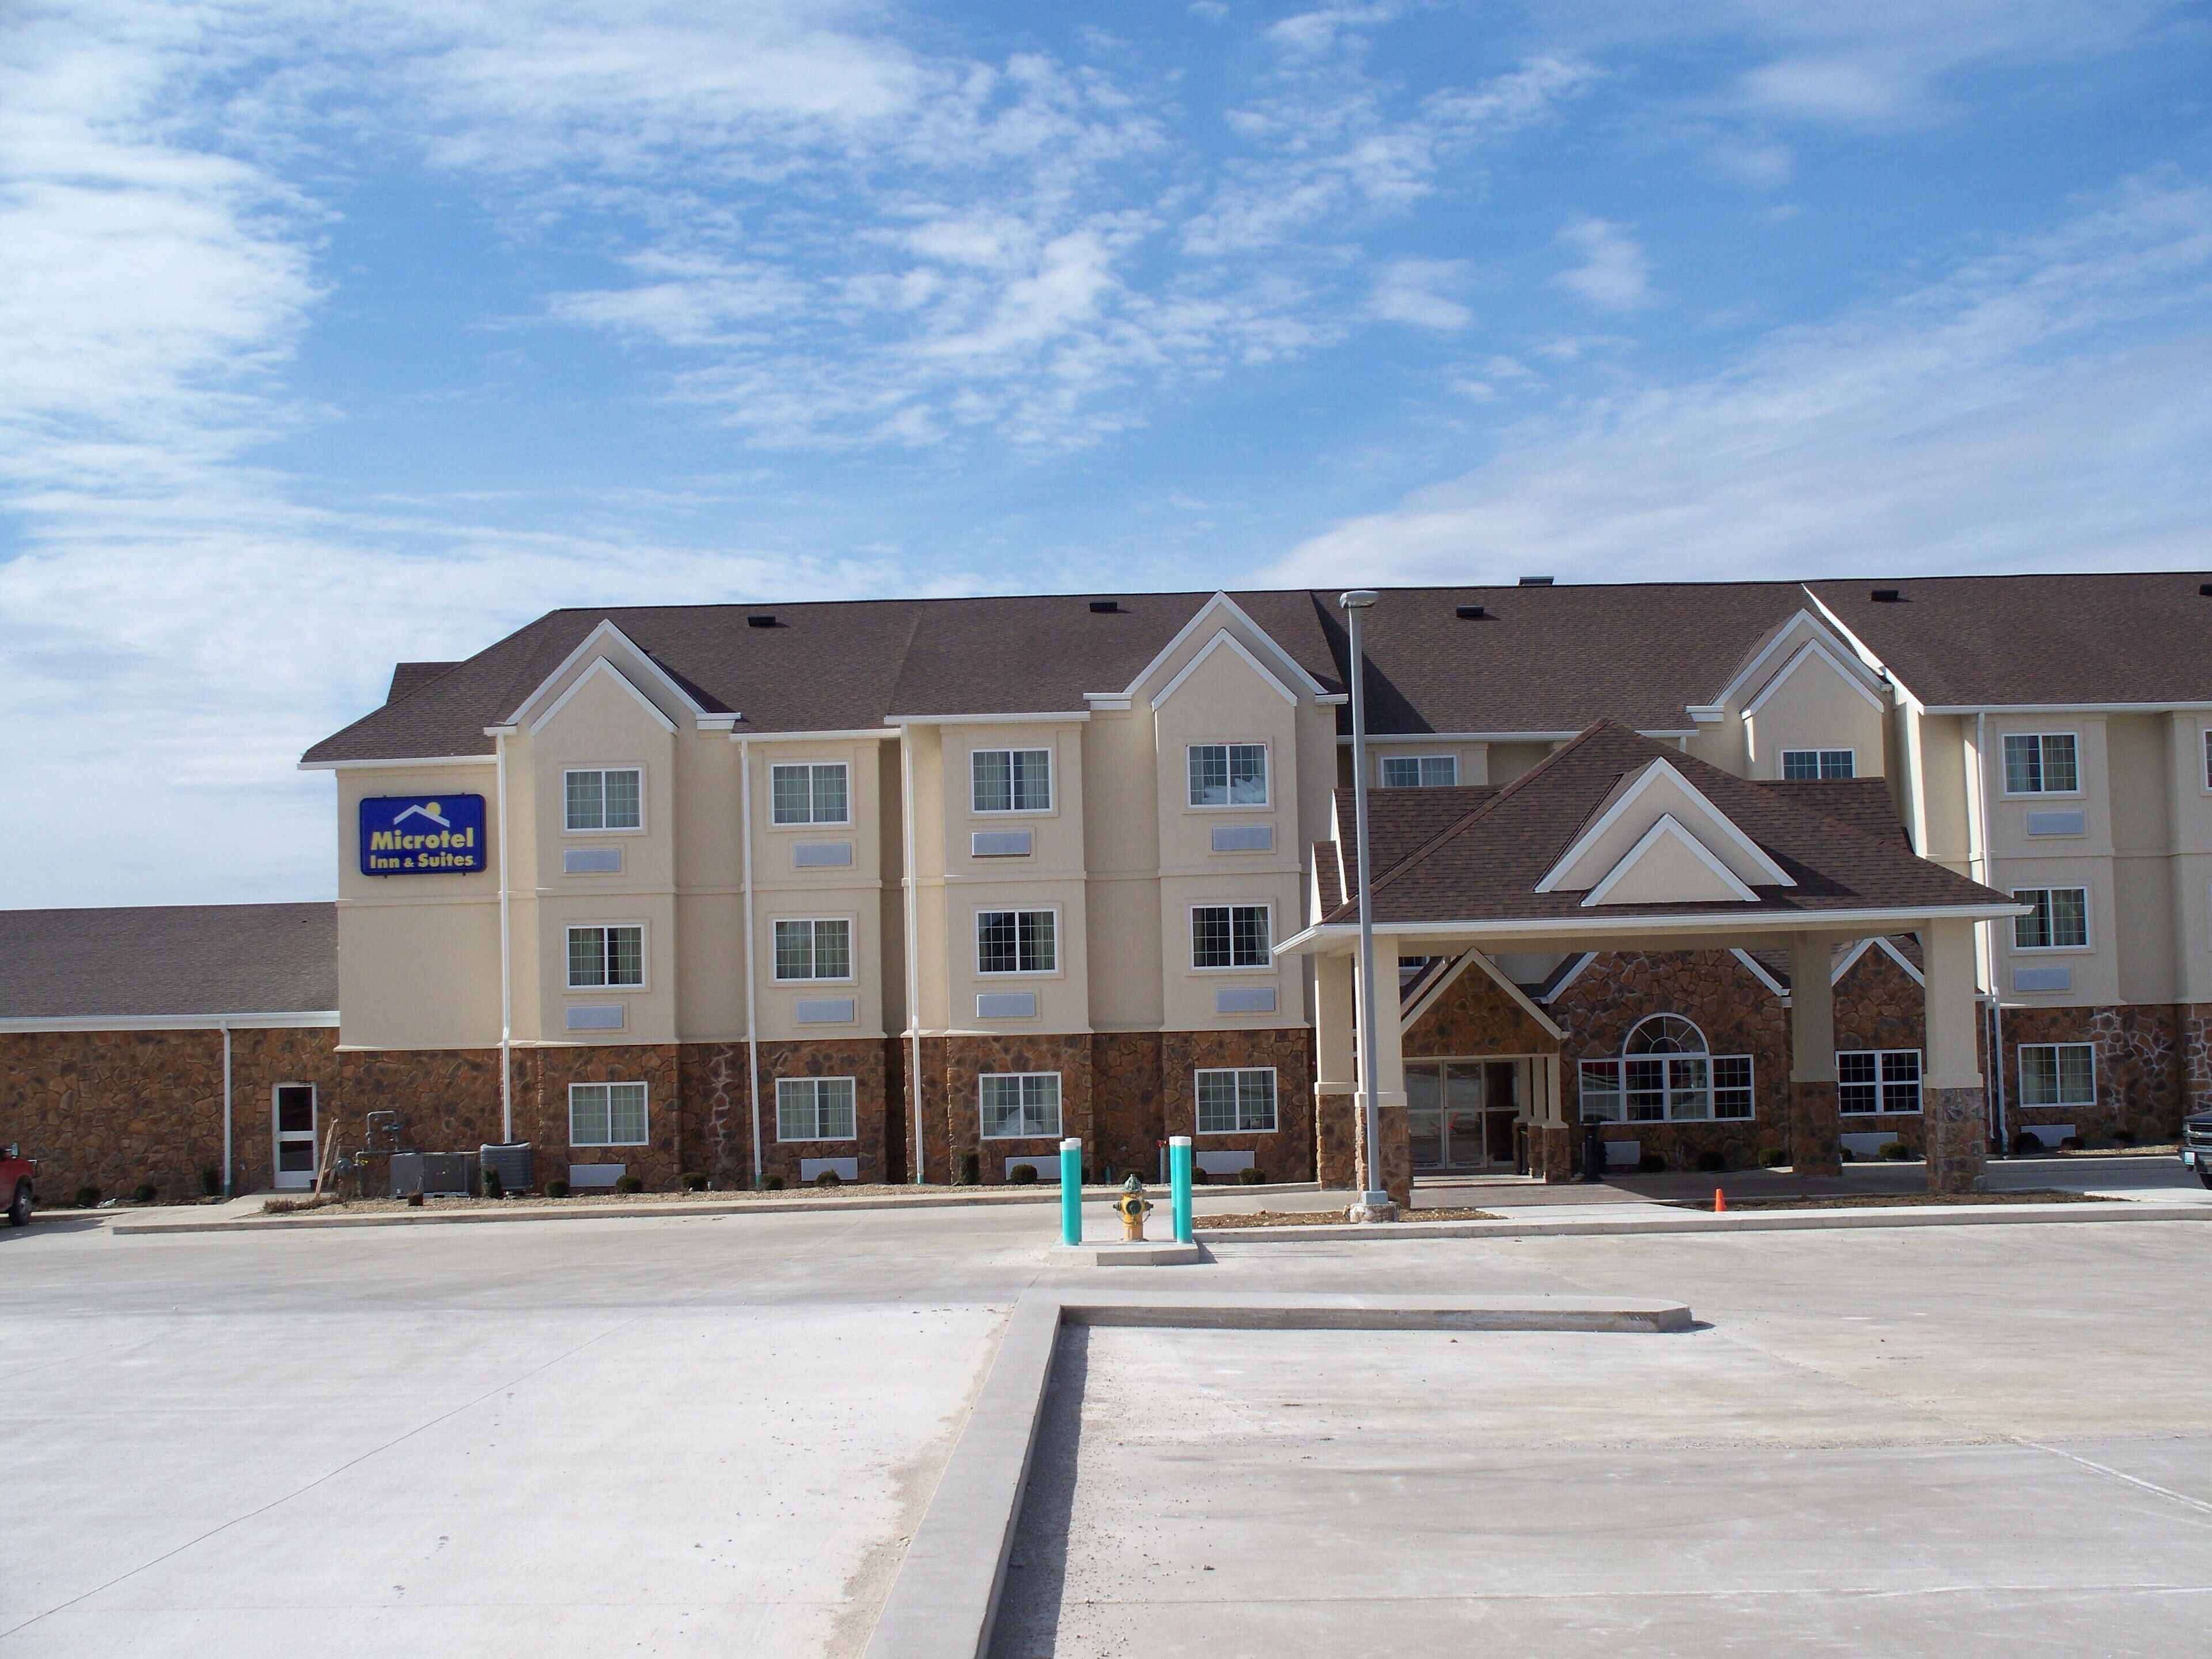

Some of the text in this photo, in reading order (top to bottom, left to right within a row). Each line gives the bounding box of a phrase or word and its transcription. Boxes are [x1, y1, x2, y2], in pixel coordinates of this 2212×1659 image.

[370, 827, 474, 851] Microtel
[370, 851, 475, 869] Inn & Suites
